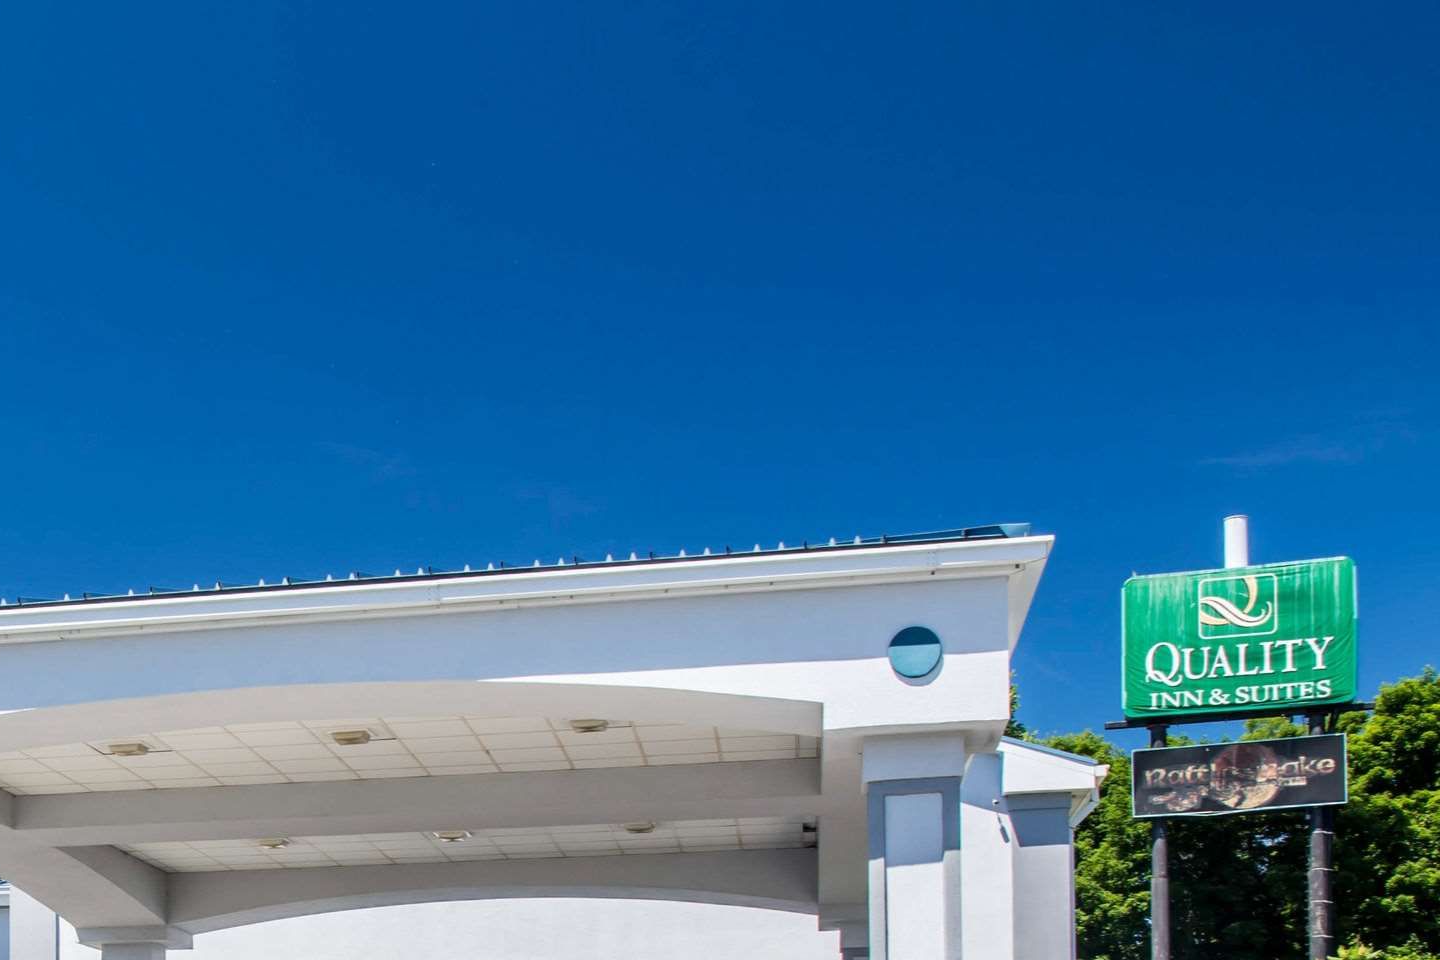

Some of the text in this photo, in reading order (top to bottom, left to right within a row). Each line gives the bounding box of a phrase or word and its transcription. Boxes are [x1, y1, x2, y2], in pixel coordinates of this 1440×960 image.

[1144, 636, 1335, 687] QUALITY
[1149, 679, 1332, 710] INN & SUITES
